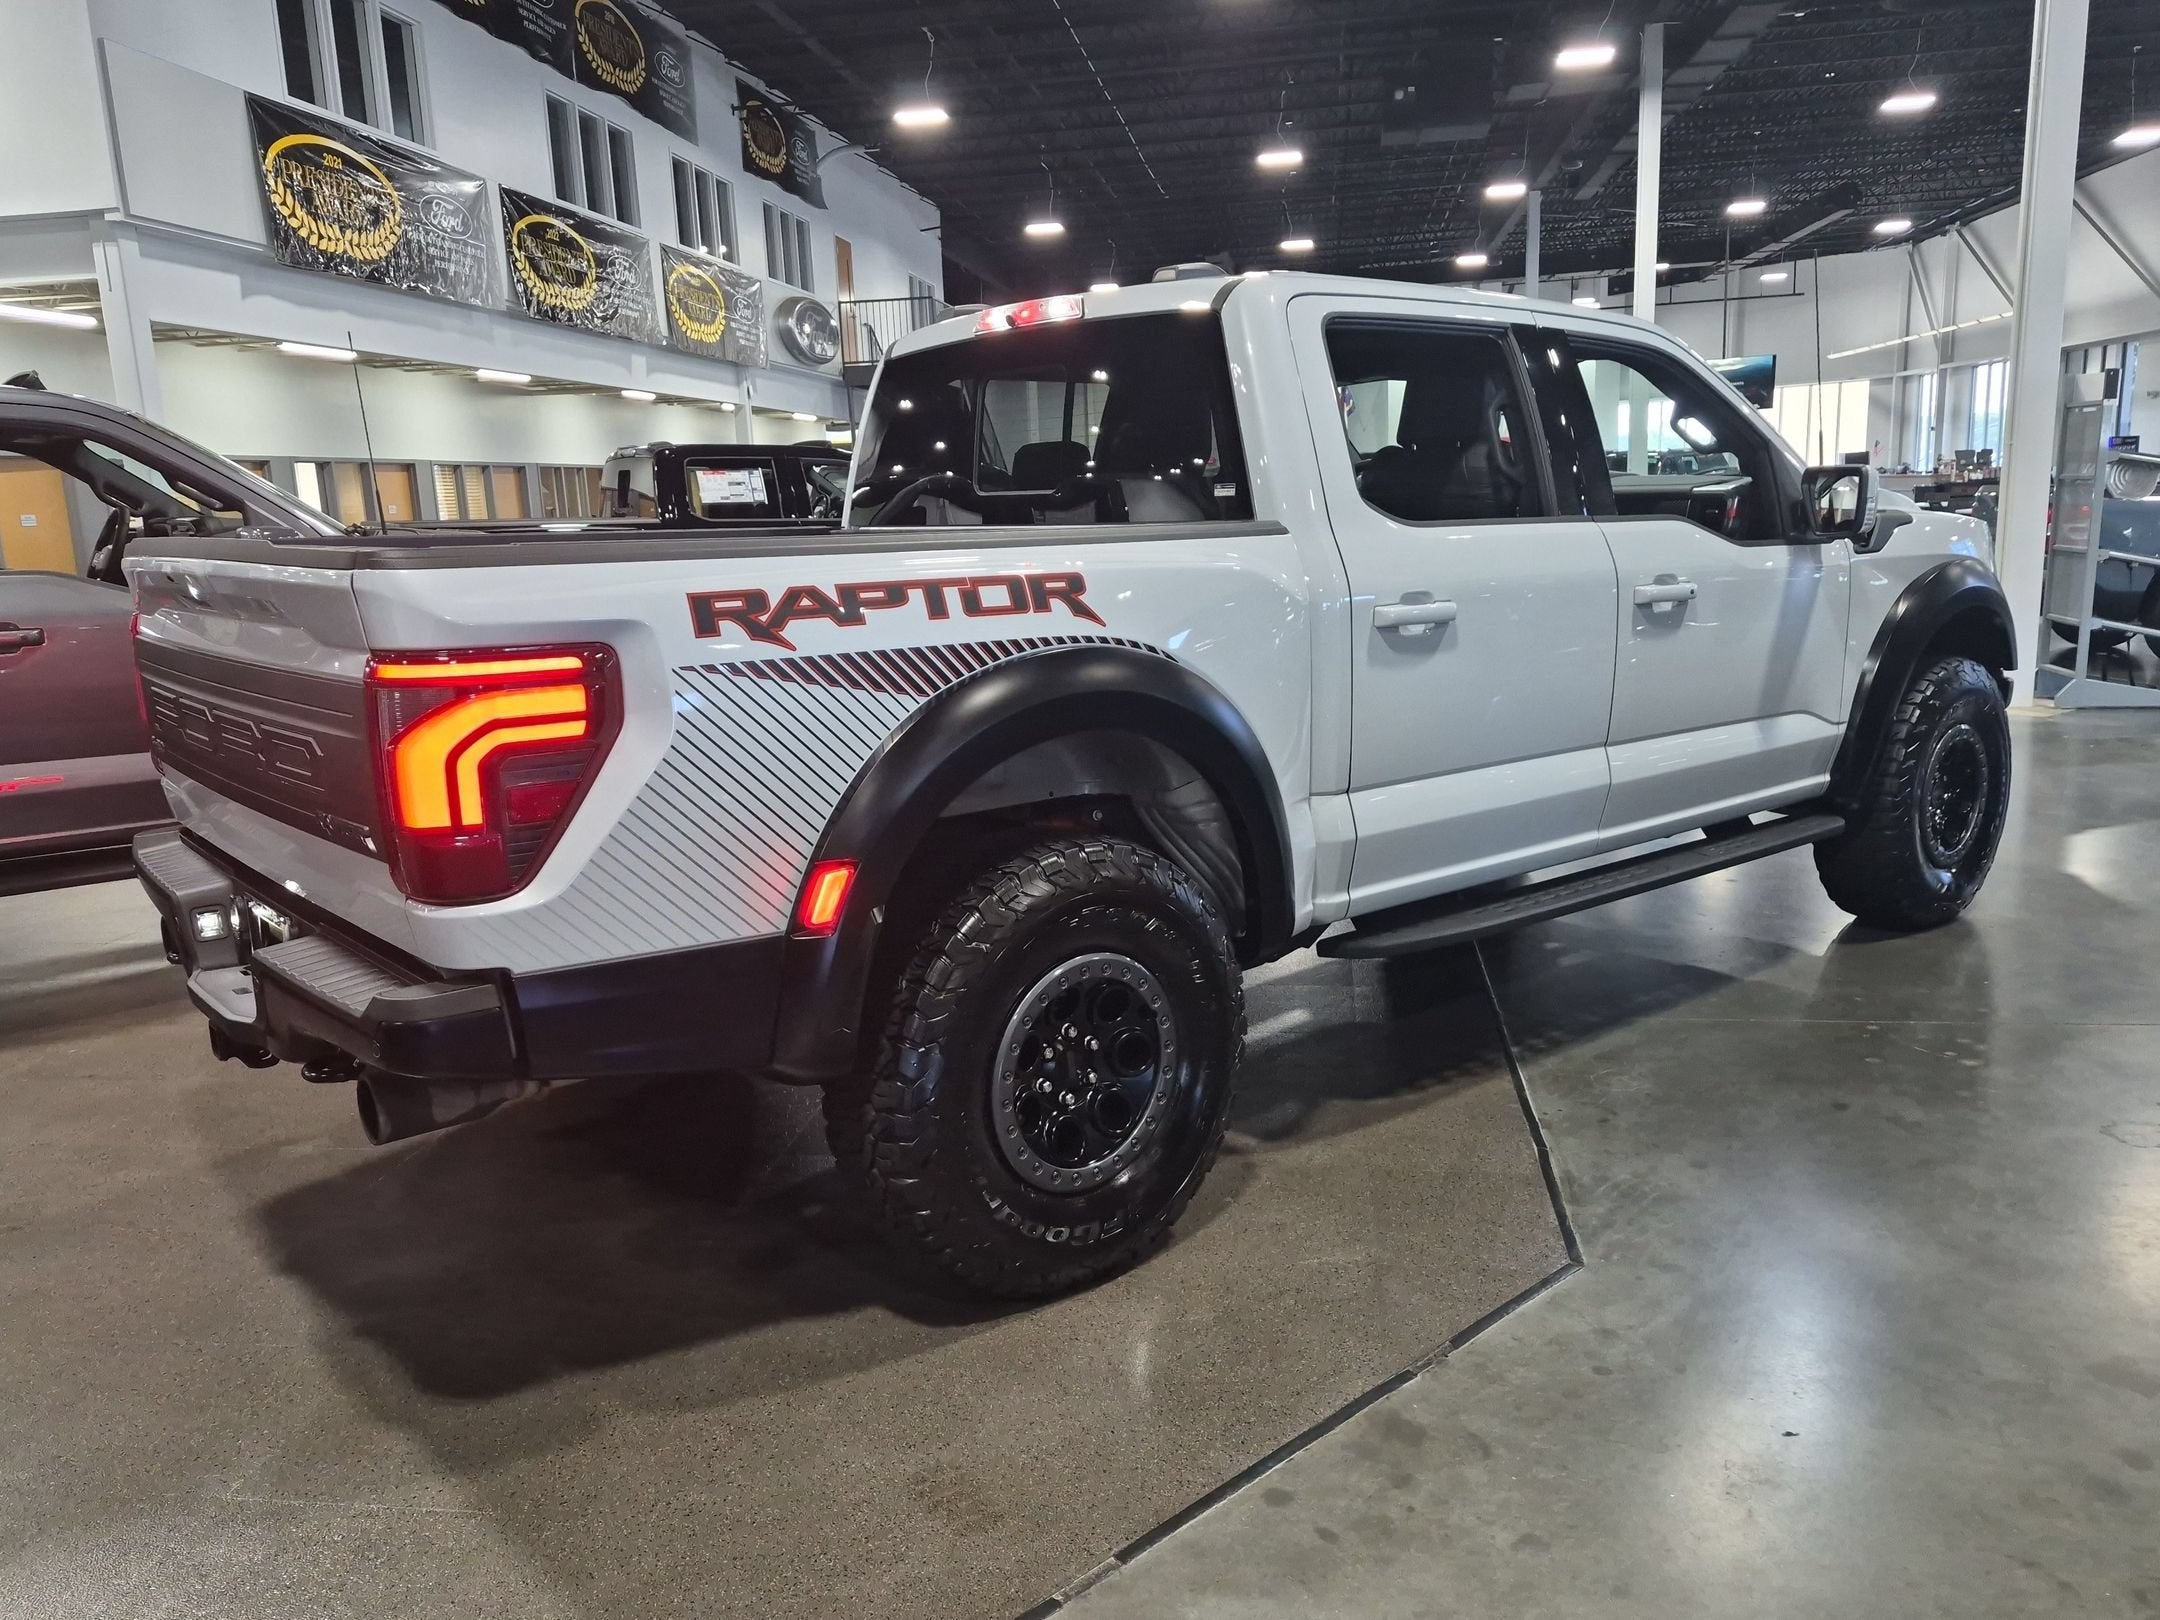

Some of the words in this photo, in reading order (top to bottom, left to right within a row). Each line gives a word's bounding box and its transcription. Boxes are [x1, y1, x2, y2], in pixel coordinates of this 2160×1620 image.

[660, 54, 682, 83] Ford
[323, 152, 343, 169] 2021
[430, 199, 464, 232] Ford
[613, 258, 637, 284] Ford
[736, 298, 752, 320] Ford
[686, 572, 1106, 651] RAPTOR
